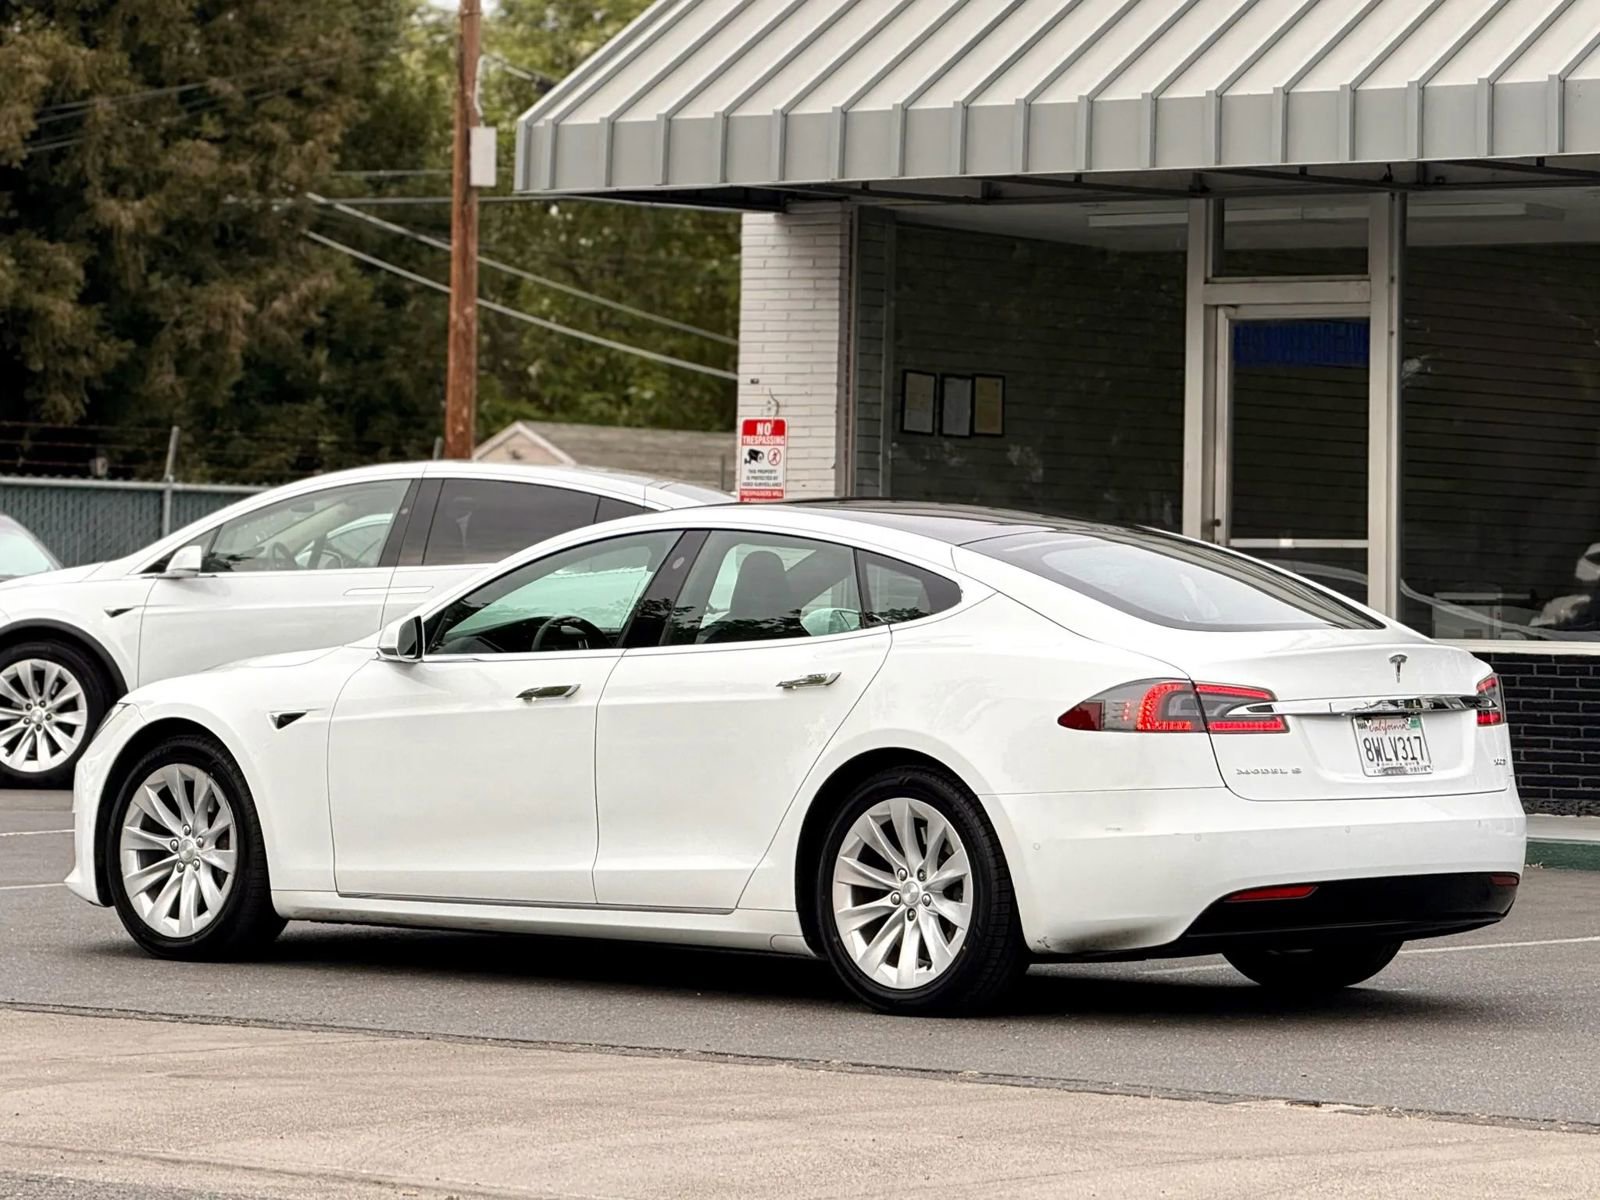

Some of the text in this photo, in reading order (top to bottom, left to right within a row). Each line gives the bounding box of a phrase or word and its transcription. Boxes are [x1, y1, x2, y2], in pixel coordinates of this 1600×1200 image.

[756, 422, 772, 436] NO
[742, 435, 785, 445] TRESPASSING
[1369, 718, 1411, 735] California
[1363, 735, 1424, 762] 8WLV317
